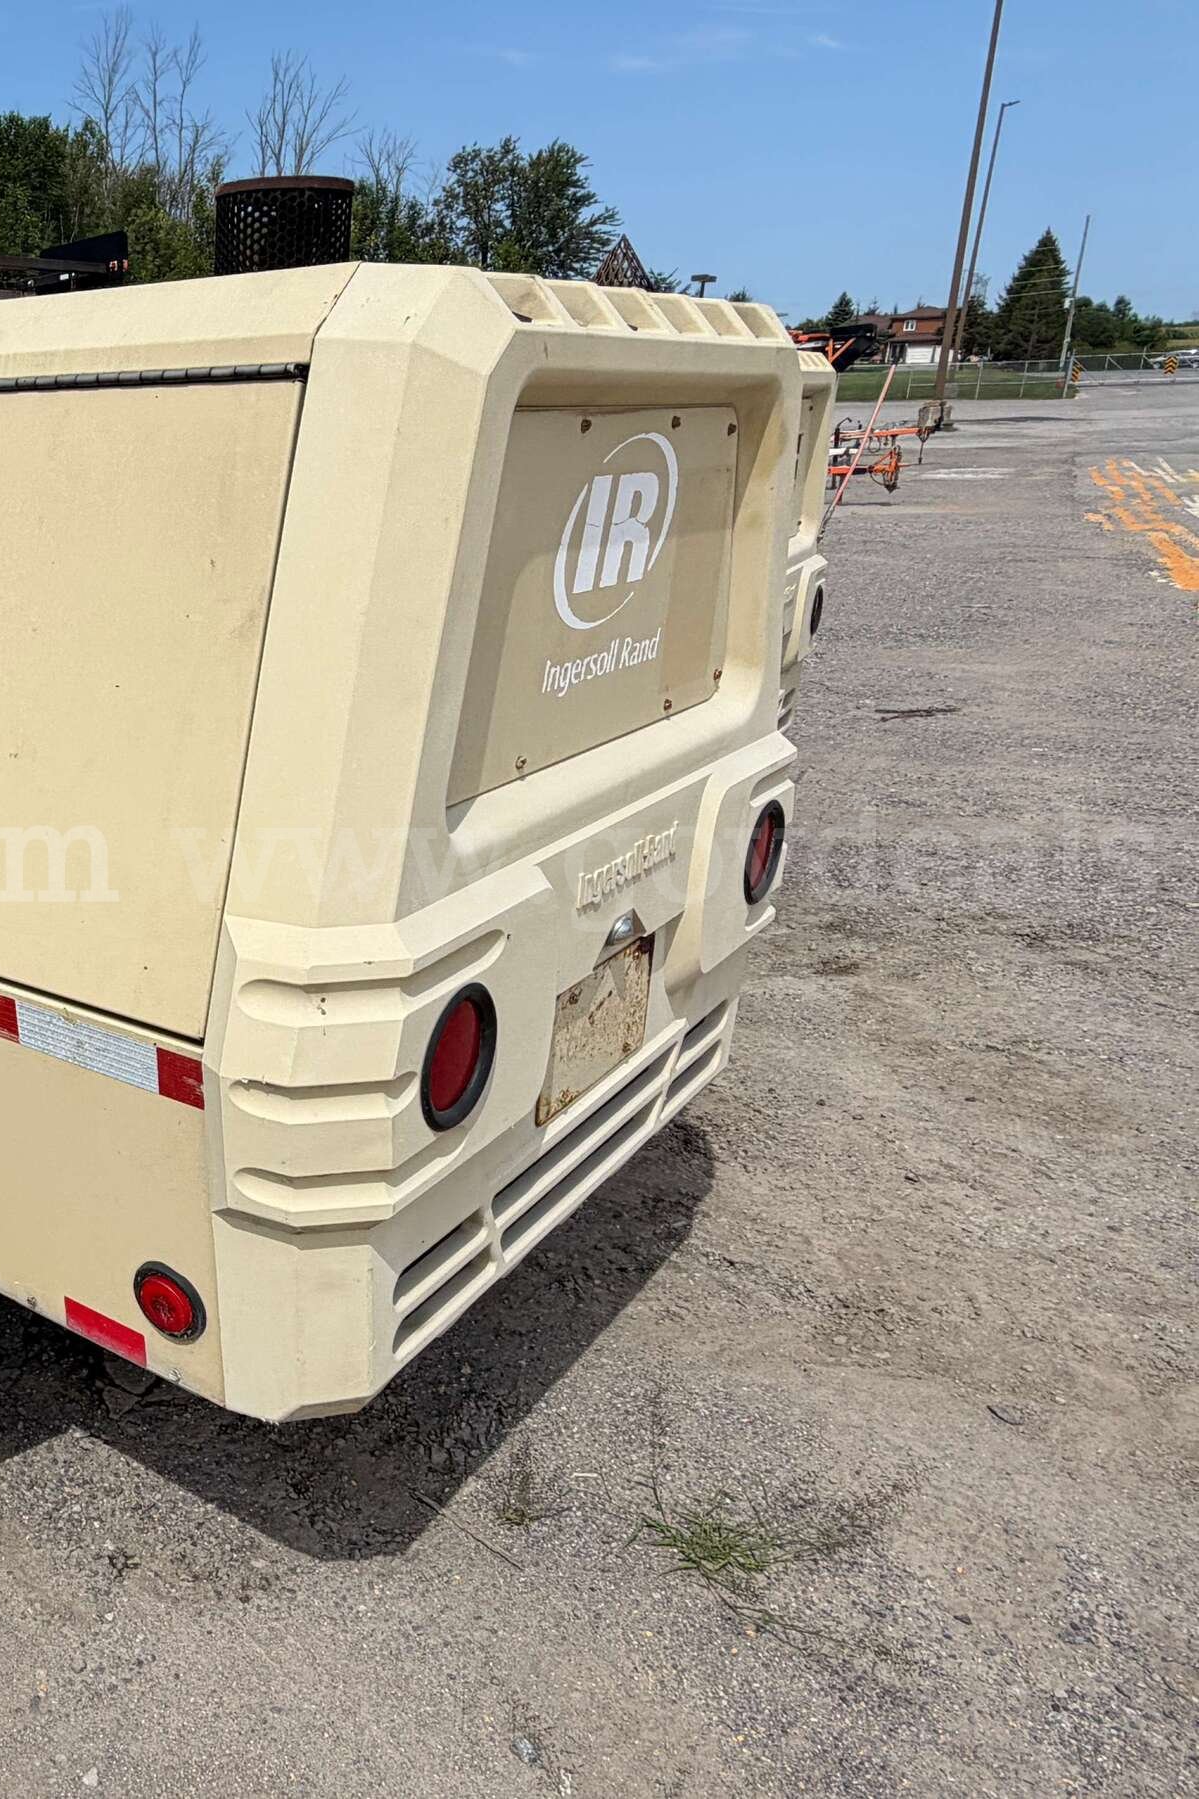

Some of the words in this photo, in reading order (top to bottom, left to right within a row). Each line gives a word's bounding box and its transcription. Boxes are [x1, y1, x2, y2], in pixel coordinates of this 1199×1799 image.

[573, 472, 660, 594] IR
[542, 639, 619, 697] Ingersoll
[619, 627, 661, 669] Rand
